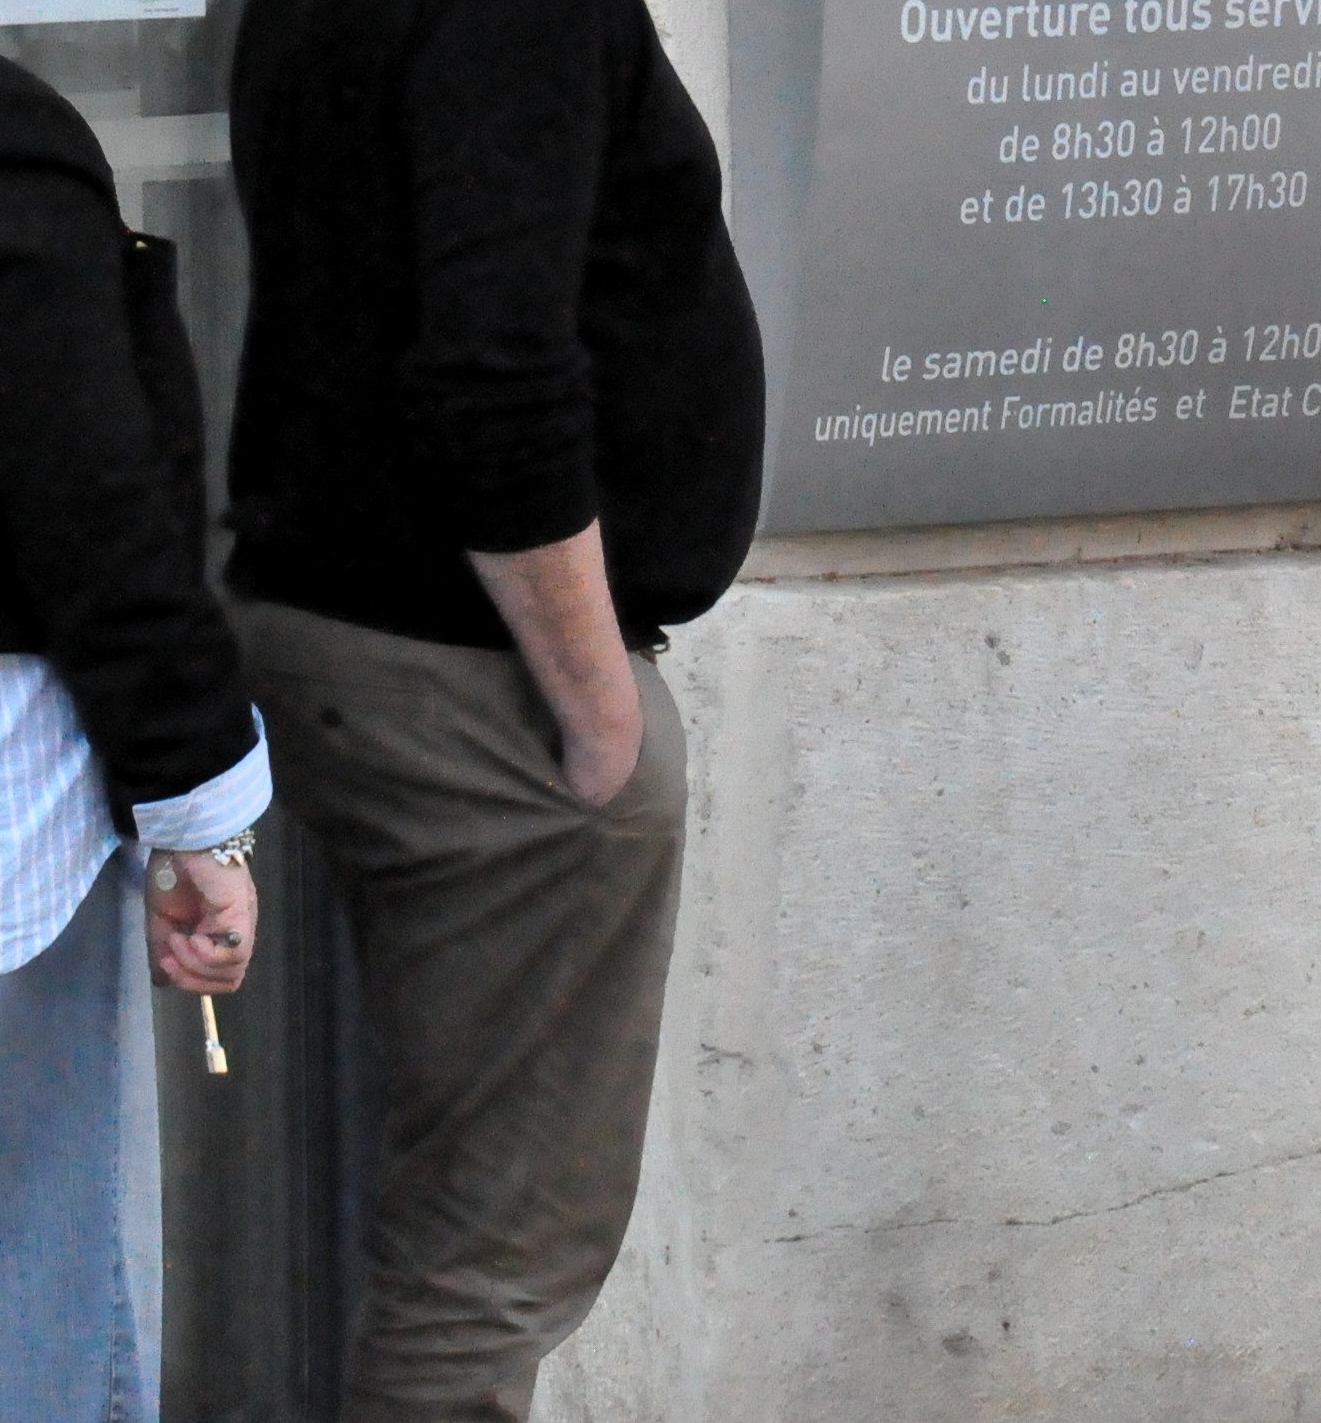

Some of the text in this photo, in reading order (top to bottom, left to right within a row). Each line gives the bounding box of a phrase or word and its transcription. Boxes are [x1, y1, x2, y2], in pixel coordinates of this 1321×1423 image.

[966, 65, 1010, 106] du
[1021, 59, 1110, 103] lundi
[1119, 68, 1162, 98] au
[998, 111, 1283, 164] de 8h30 à 12h00
[959, 169, 1309, 226] et de 13h30 à 17h30
[880, 345, 913, 384] le
[921, 336, 1054, 381] samedi
[1061, 334, 1105, 373] de
[1113, 328, 1200, 370] 8h30
[1206, 324, 1228, 365] à
[813, 397, 992, 447] uniquement
[999, 384, 1159, 431] Formalités
[1174, 386, 1207, 420] et
[1227, 383, 1294, 420] Etat
